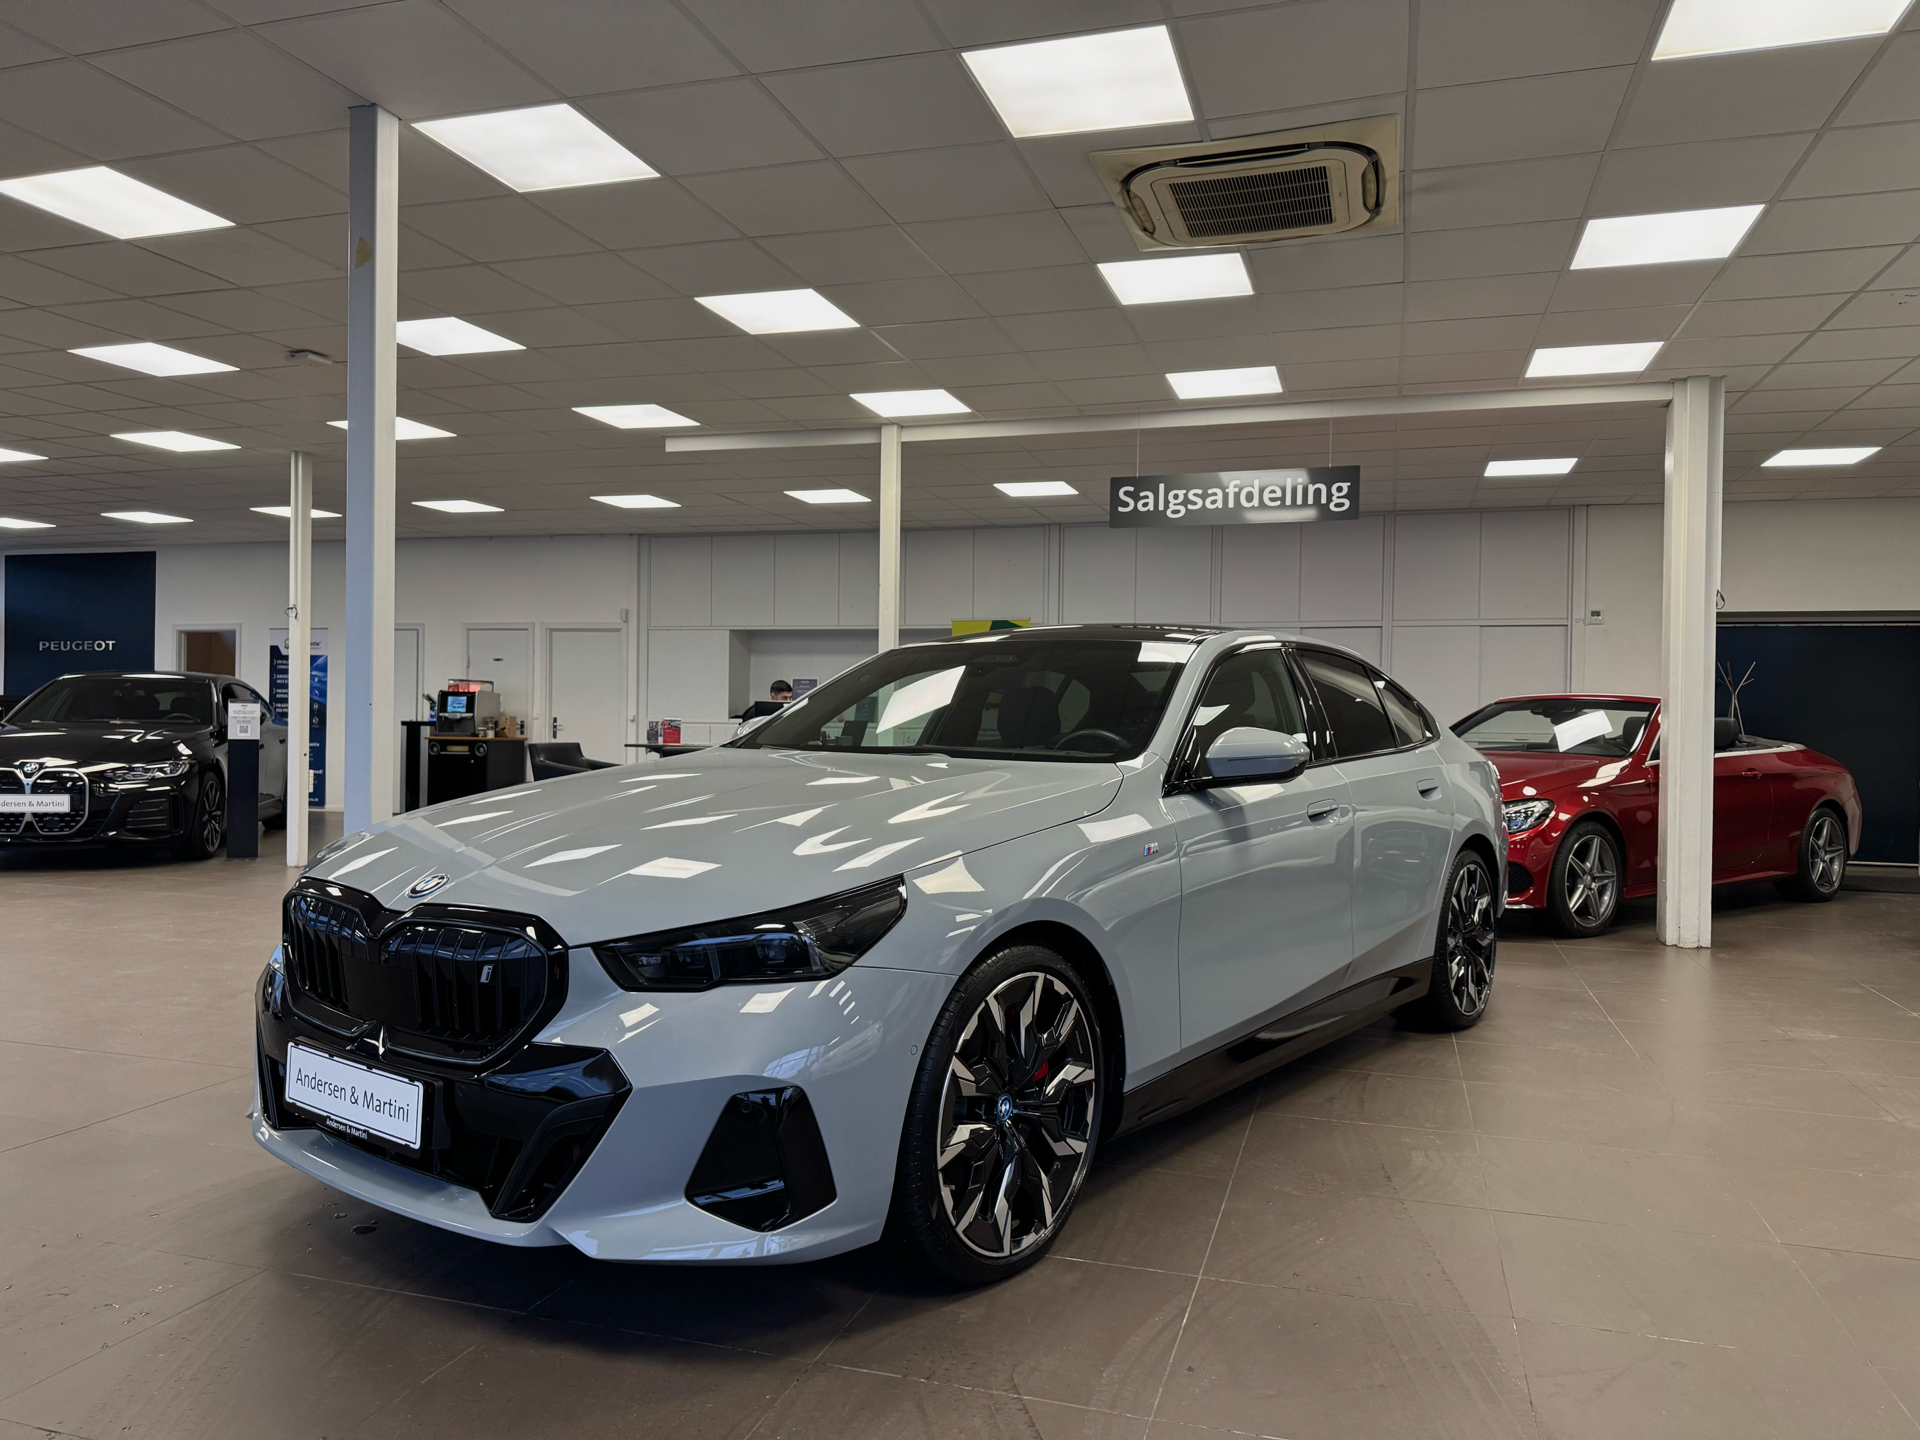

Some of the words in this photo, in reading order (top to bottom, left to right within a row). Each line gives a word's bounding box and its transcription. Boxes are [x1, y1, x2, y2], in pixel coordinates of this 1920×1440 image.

[1117, 477, 1351, 519] Salgsafdeling
[39, 640, 117, 652] PEUGEOT
[27, 800, 35, 808] &
[36, 800, 65, 808] Martini
[295, 1067, 347, 1102] Andersen
[349, 1085, 360, 1106] &
[362, 1090, 410, 1123] Martini
[326, 1117, 346, 1132] Andersen
[351, 1127, 368, 1140] Martini
